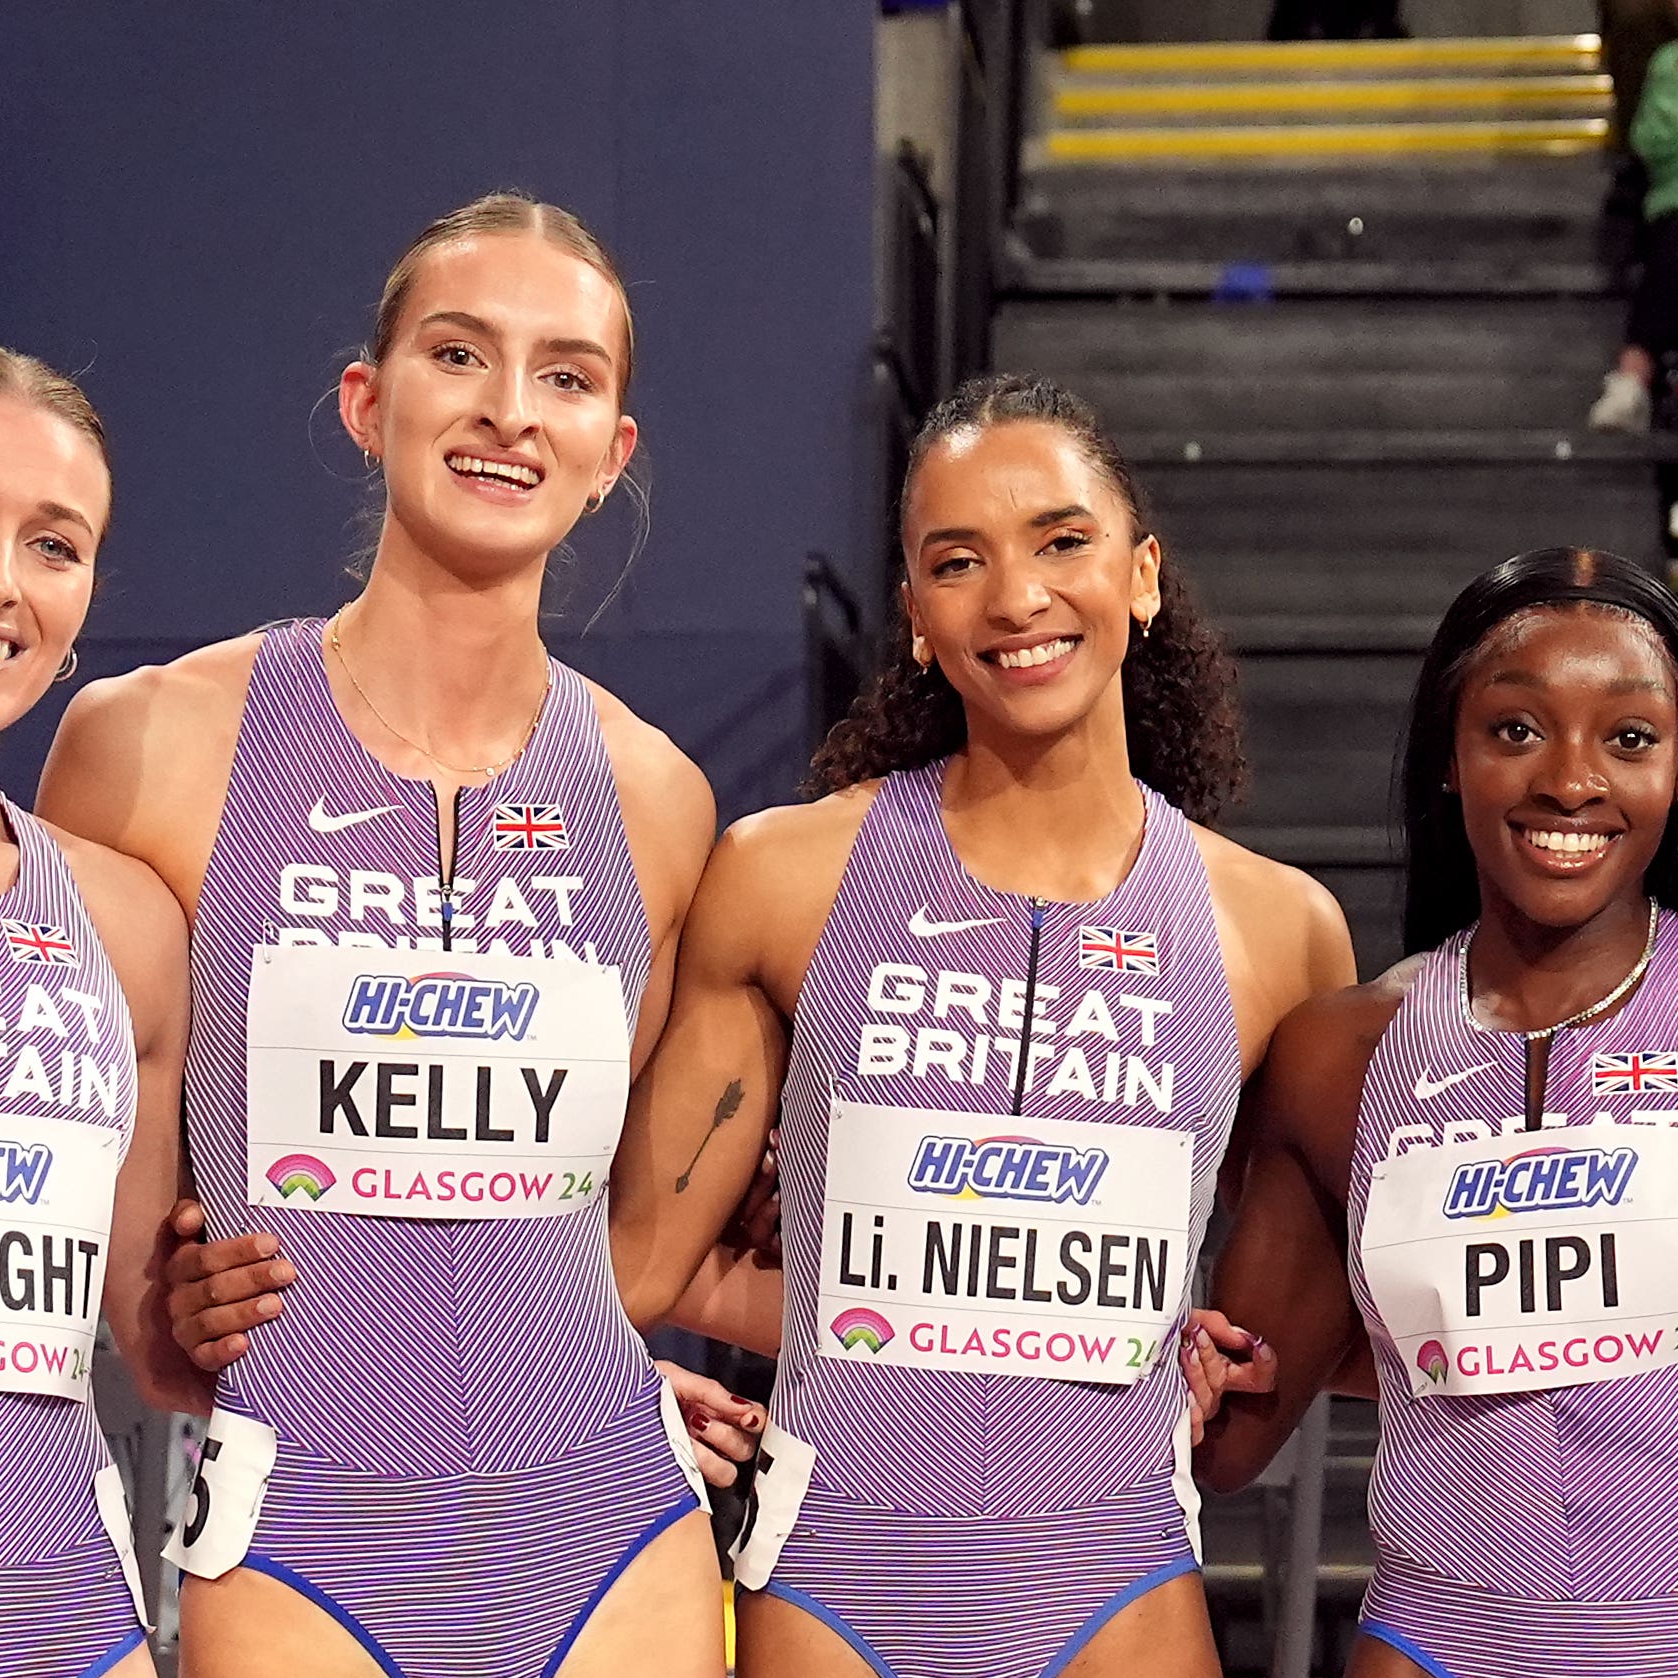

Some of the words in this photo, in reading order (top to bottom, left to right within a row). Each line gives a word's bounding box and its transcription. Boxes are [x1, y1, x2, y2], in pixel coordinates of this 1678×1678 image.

[279, 863, 584, 929] GREAT
[342, 974, 539, 1041] HI-CHEW
[867, 962, 1173, 1047] GREAT
[318, 1059, 568, 1143] KELLY
[858, 1024, 1174, 1113] BRITAIN
[352, 1168, 553, 1202] GLASGOW
[559, 1172, 593, 1201] 24
[908, 1135, 1108, 1205] HI-CHEW
[1443, 1147, 1637, 1219] HI-CHEW
[838, 1212, 897, 1291] Li.
[923, 1220, 1168, 1312] NIELSEN
[1464, 1233, 1619, 1316] PIPI
[909, 1323, 1116, 1365] GLASGOW
[1457, 1328, 1663, 1376] GLASGOW
